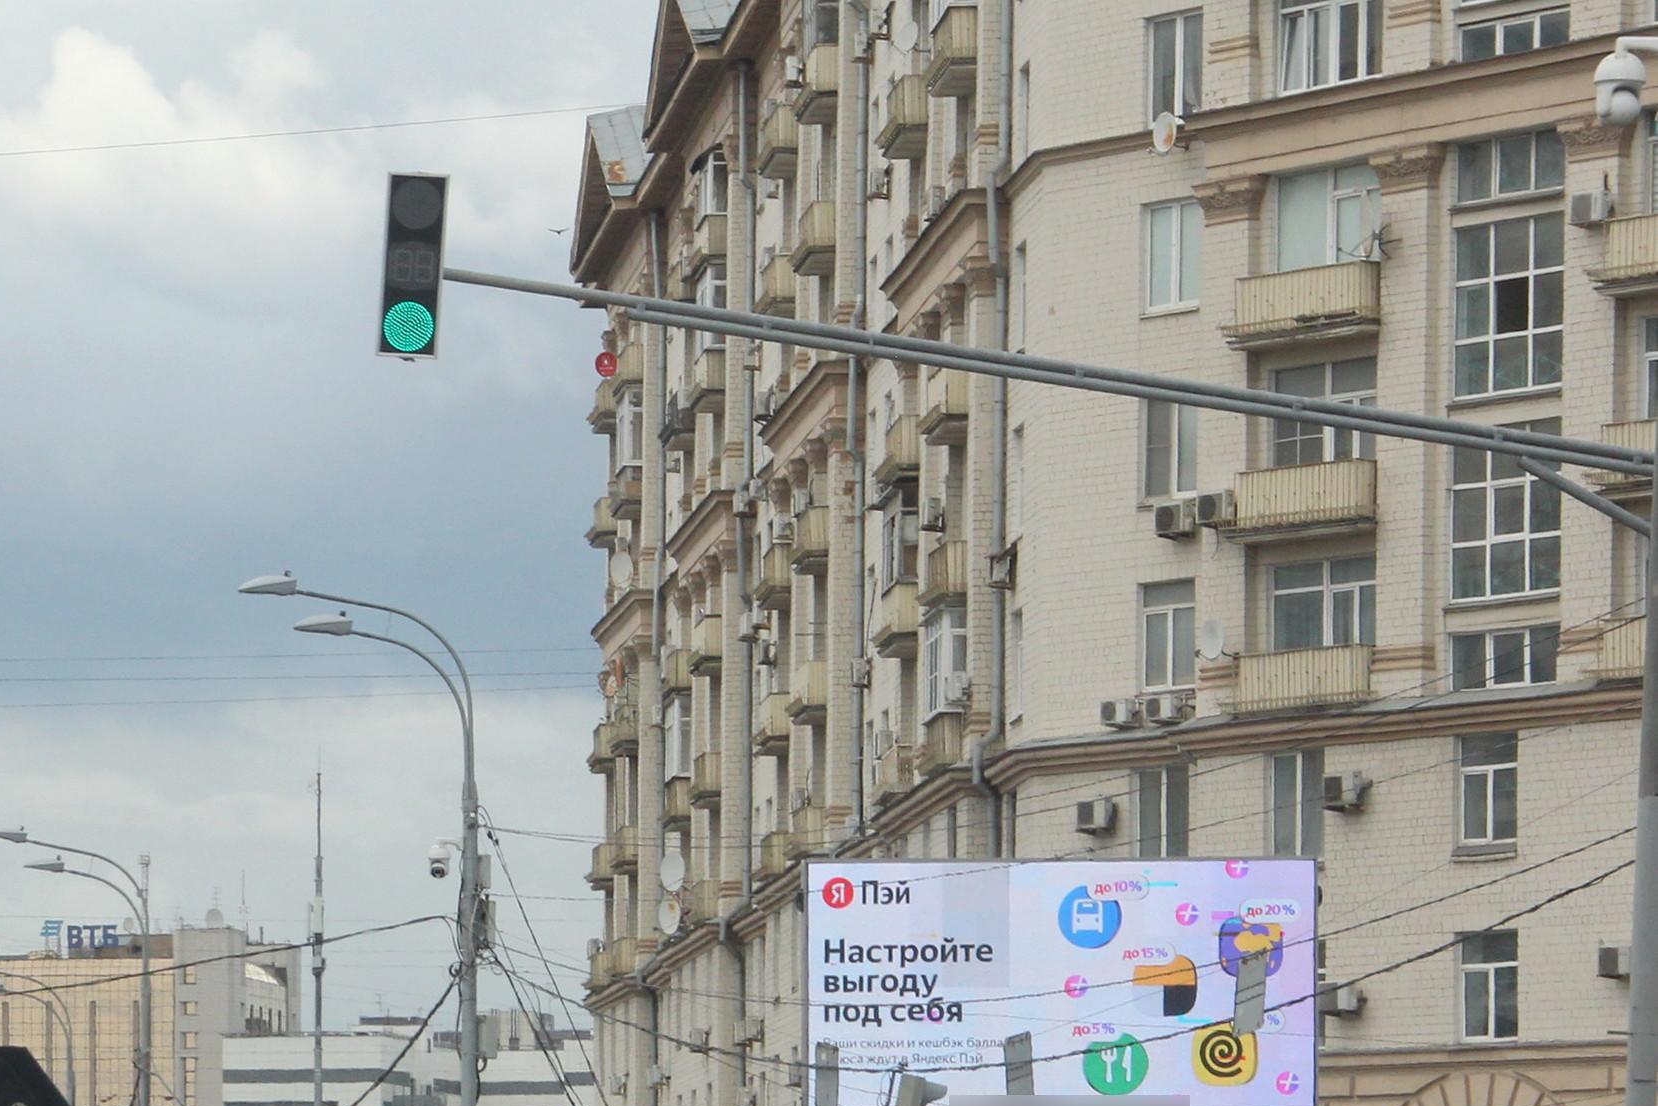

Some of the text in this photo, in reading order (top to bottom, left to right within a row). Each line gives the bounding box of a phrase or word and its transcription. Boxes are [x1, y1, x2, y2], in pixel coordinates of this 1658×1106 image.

[861, 879, 911, 905] Пэй
[1094, 882, 1112, 895] до
[67, 924, 119, 949] ВТБ
[823, 937, 994, 968] Настройте
[1122, 947, 1140, 961] до
[823, 973, 939, 999] выгоду
[823, 996, 963, 1028] под себя
[1072, 1022, 1090, 1036] до
[860, 1039, 904, 1050] скидки
[907, 1039, 916, 1048] и
[918, 1037, 964, 1048] кешбэк
[911, 1053, 956, 1066] Яндекс
[959, 1052, 983, 1064] Пэй
